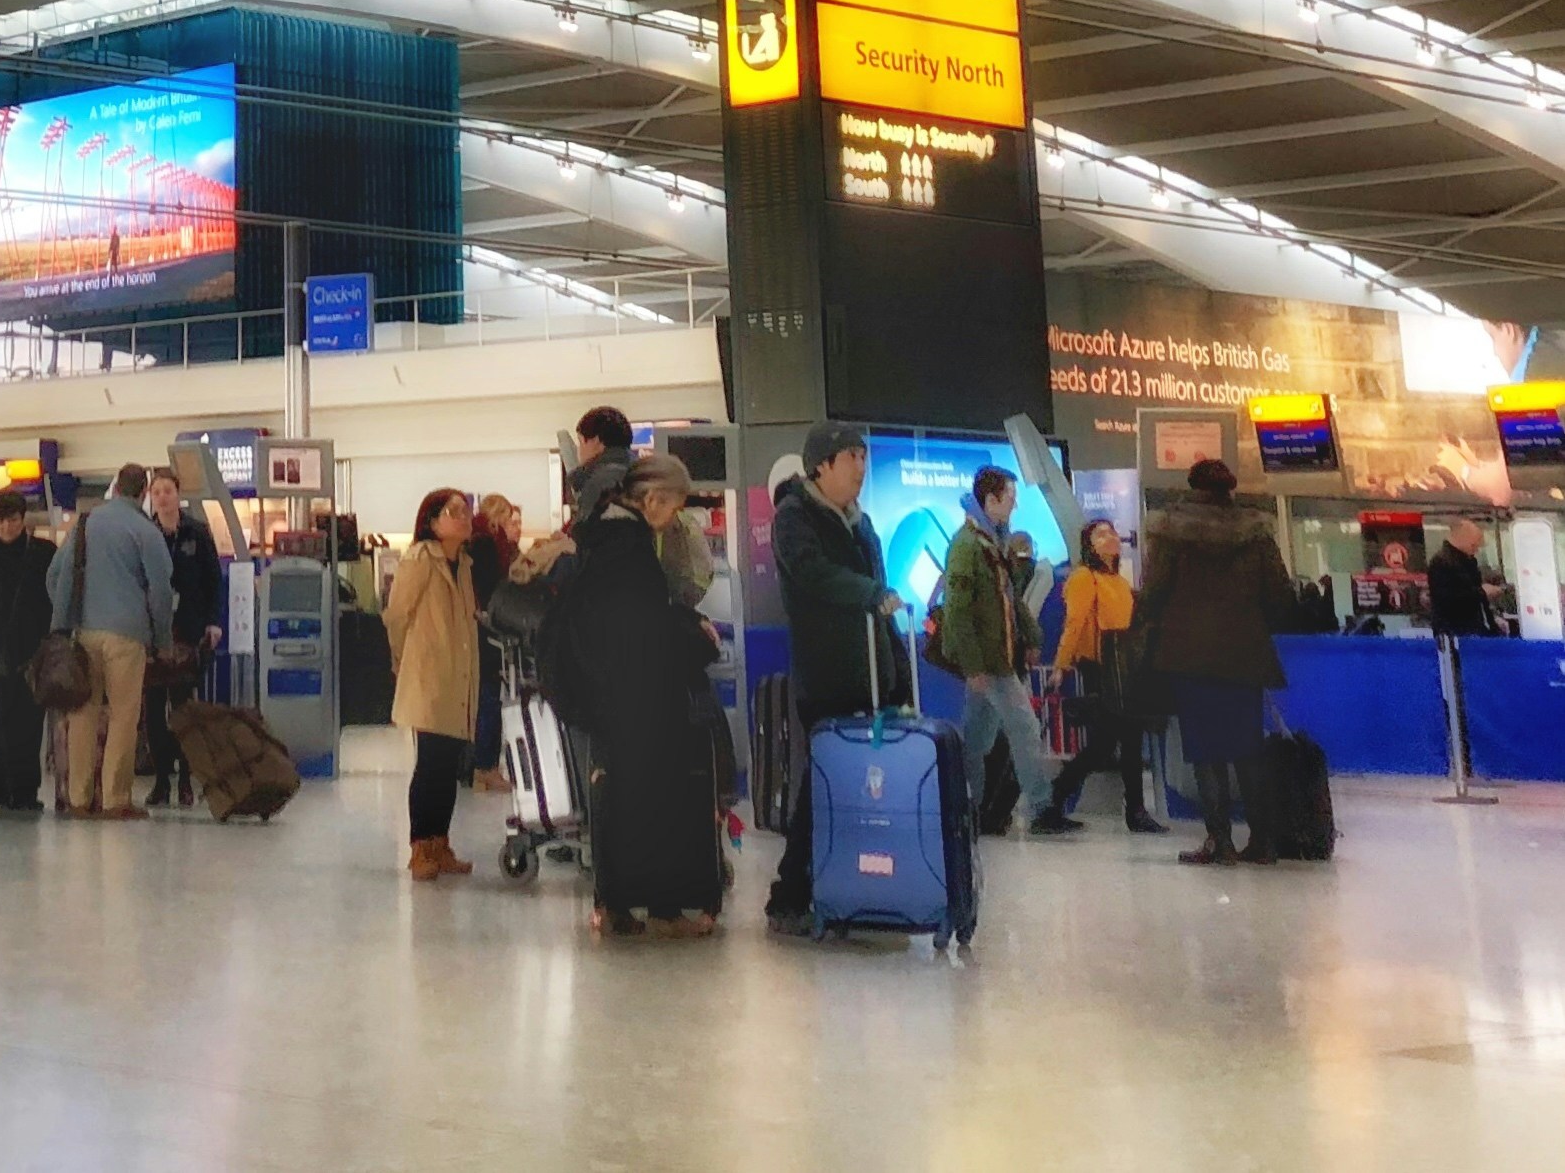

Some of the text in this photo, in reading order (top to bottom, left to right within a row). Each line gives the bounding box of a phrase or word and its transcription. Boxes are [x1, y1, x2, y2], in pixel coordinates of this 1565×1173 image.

[856, 40, 1004, 89] Security North
[90, 106, 98, 120] A
[99, 103, 117, 119] Tale
[119, 98, 129, 115] of
[841, 113, 877, 139] How
[879, 118, 914, 149] busy
[915, 123, 929, 147] is
[843, 146, 887, 174] North
[844, 173, 890, 199] South
[23, 271, 156, 299] You arrive at the end of the horizon
[313, 284, 362, 305] Check-in
[1119, 331, 1165, 360] Azure
[1169, 335, 1210, 371] helps
[1213, 341, 1258, 370] British
[1262, 346, 1290, 373] Gas
[1091, 367, 1107, 393] of
[1111, 369, 1142, 397] 21.3
[1146, 372, 1197, 401] million
[218, 446, 252, 459] EXCESS
